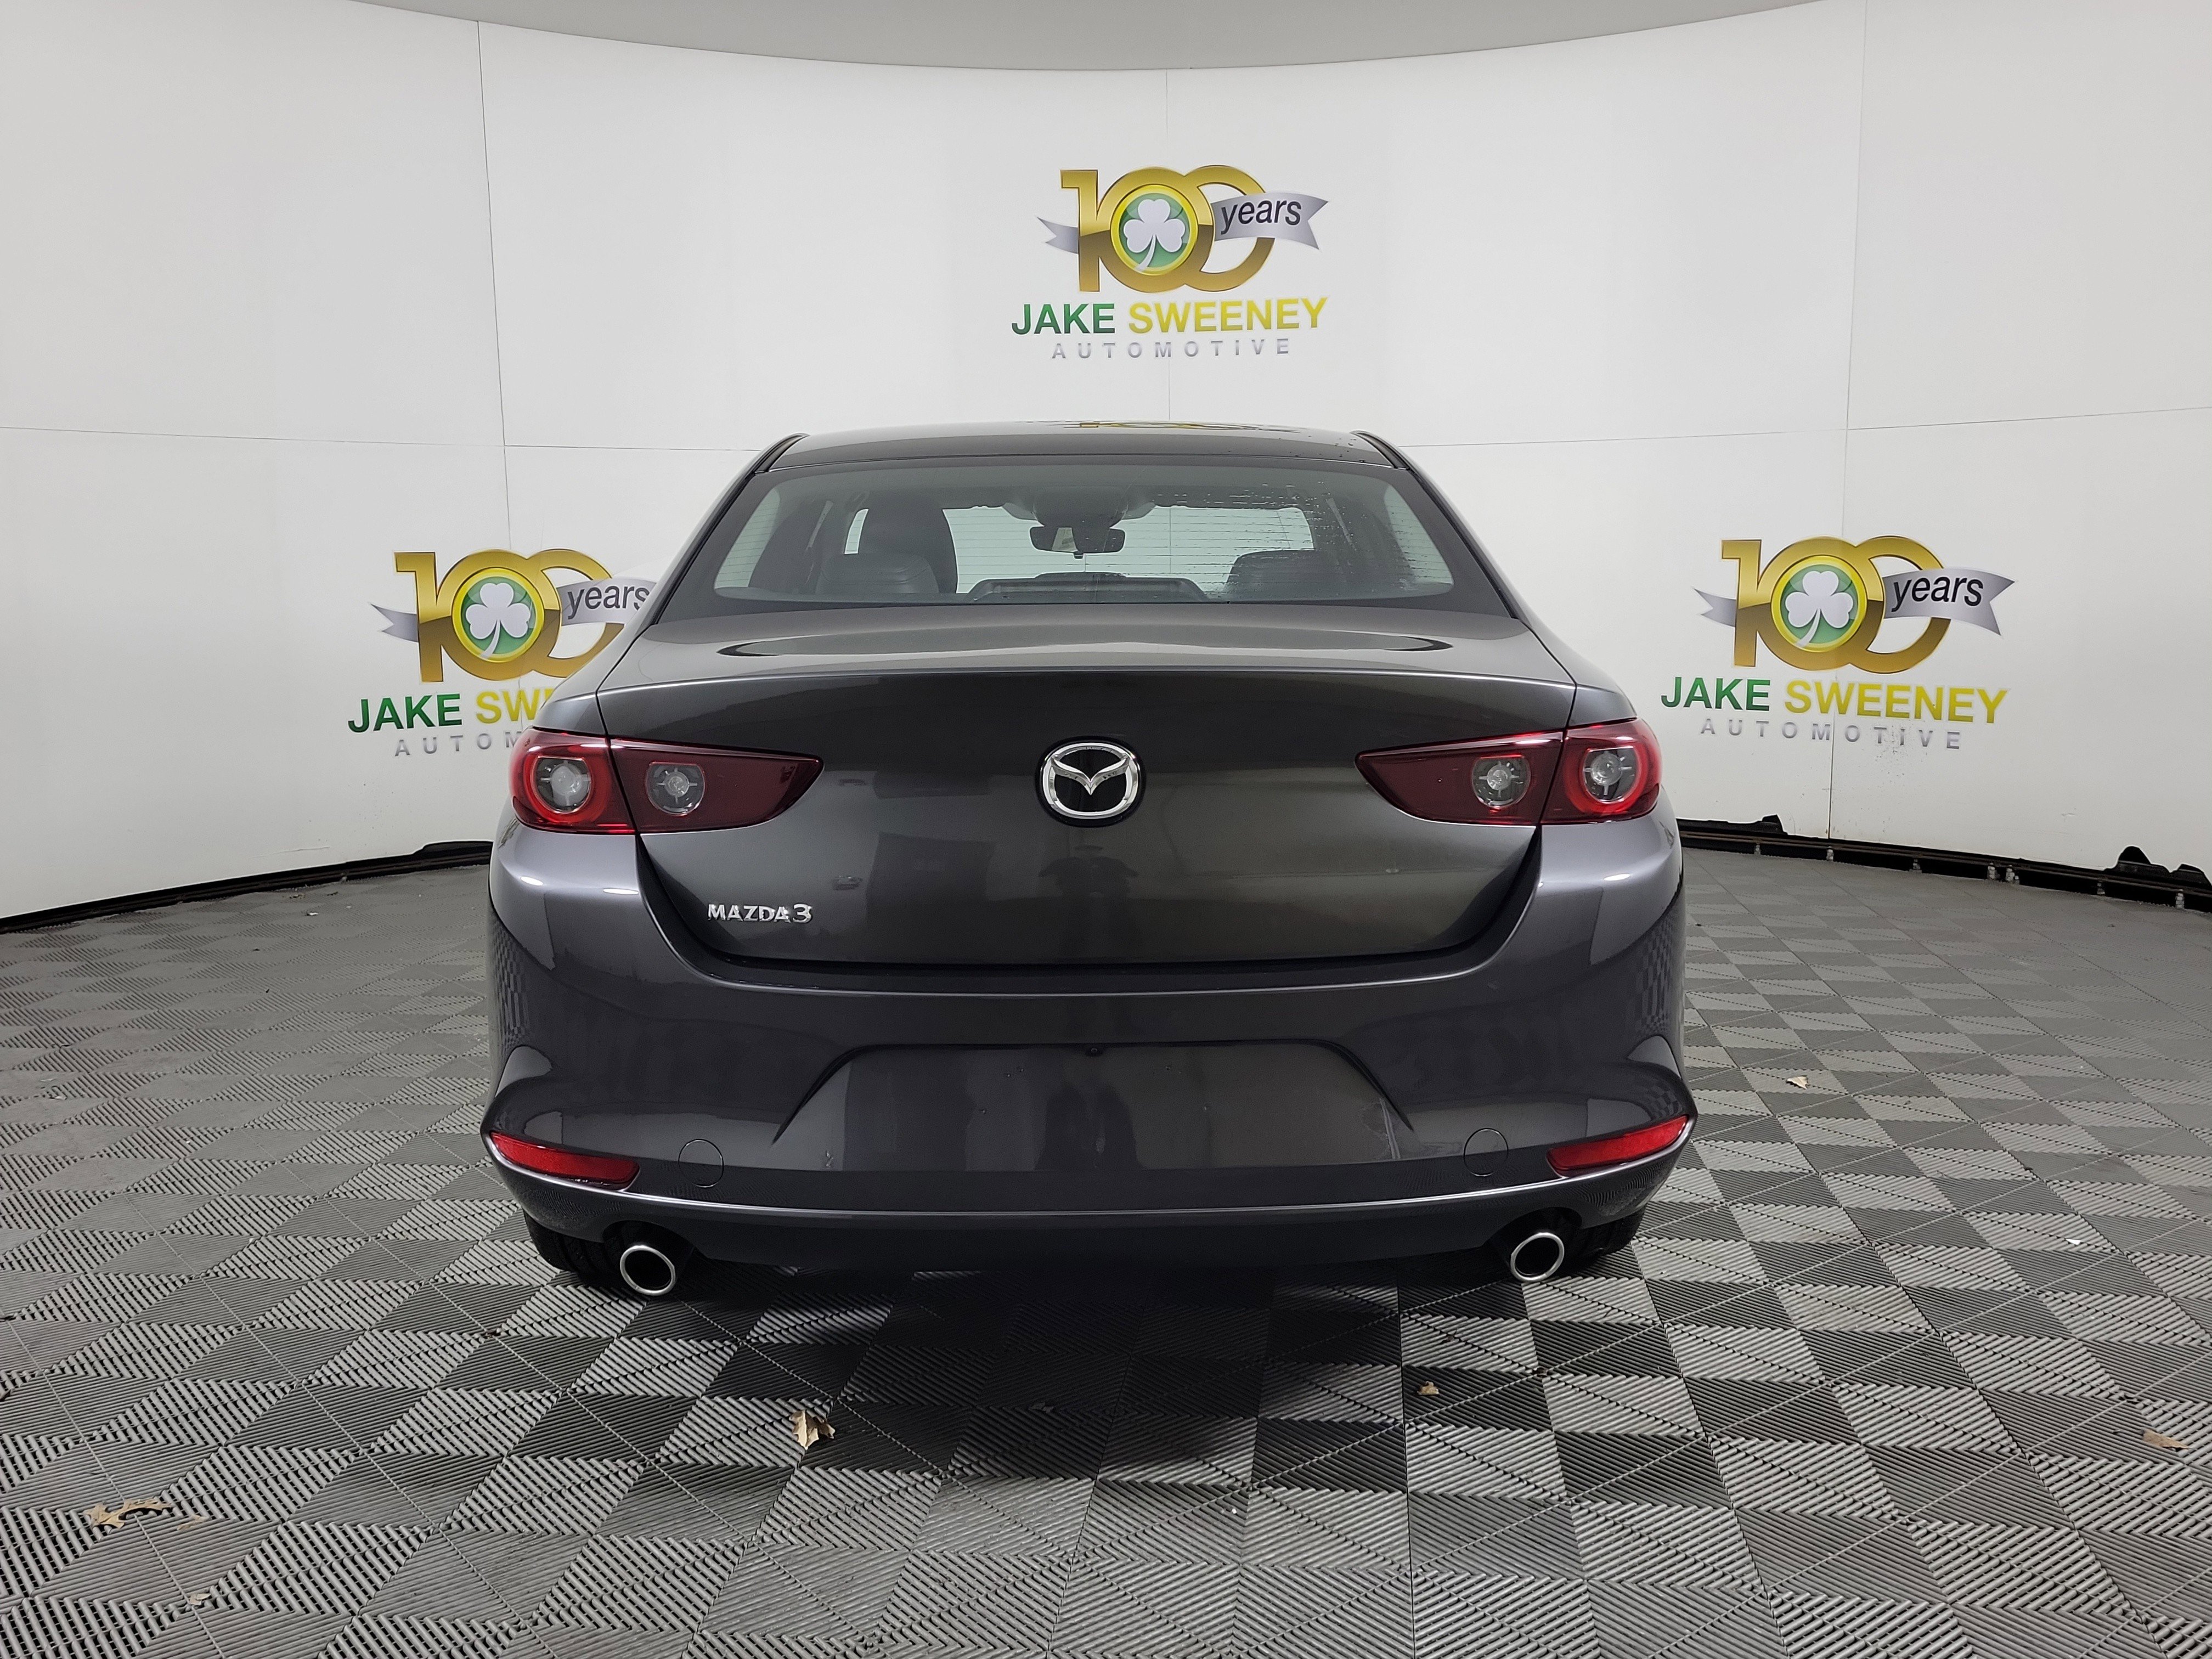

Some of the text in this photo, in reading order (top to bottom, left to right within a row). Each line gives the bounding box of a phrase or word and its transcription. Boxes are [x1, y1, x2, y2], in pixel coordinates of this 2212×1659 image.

[1221, 199, 1302, 234] years
[1011, 297, 1328, 335] JAKE SWEENEY
[1052, 338, 1289, 359] AUTOMOTIVE
[567, 585, 650, 619] years
[1891, 577, 1984, 612] years
[347, 693, 462, 733] JAKE
[1661, 676, 2008, 724] JAKE SWEENEY
[1701, 718, 1960, 750] AUTOMOTIVE
